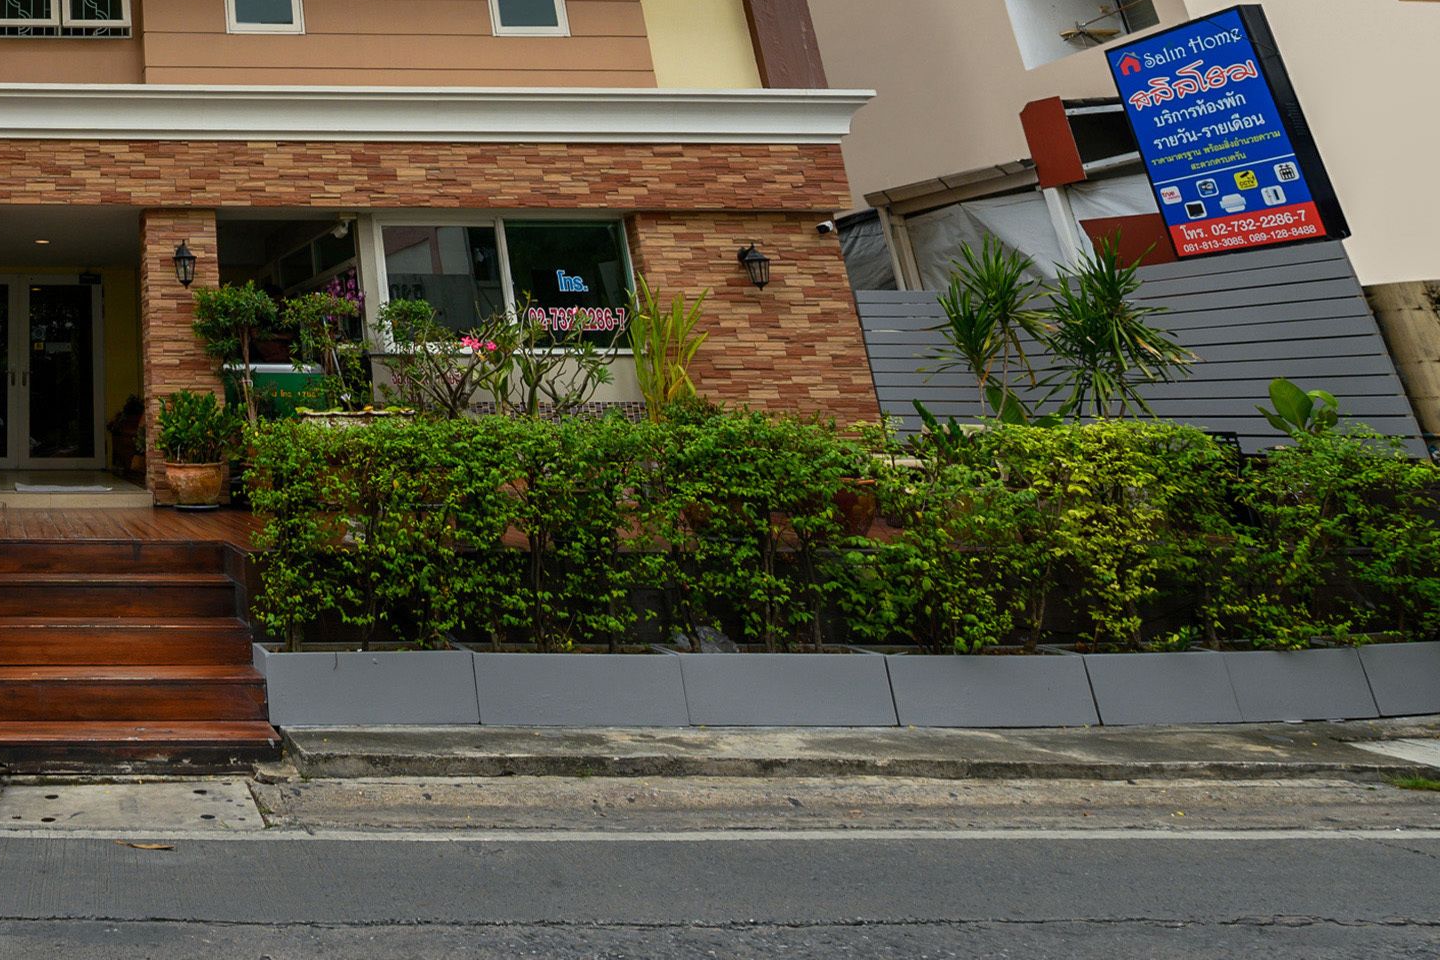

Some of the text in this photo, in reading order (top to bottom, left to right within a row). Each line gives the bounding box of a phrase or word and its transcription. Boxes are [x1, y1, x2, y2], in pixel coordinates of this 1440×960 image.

[1143, 27, 1243, 69] Salin Home
[1153, 91, 1247, 128] บริการห้องพัก
[1153, 112, 1266, 151] รายวัน-รายเดือน
[1179, 209, 1307, 241] โทร. 02-732-2286-7
